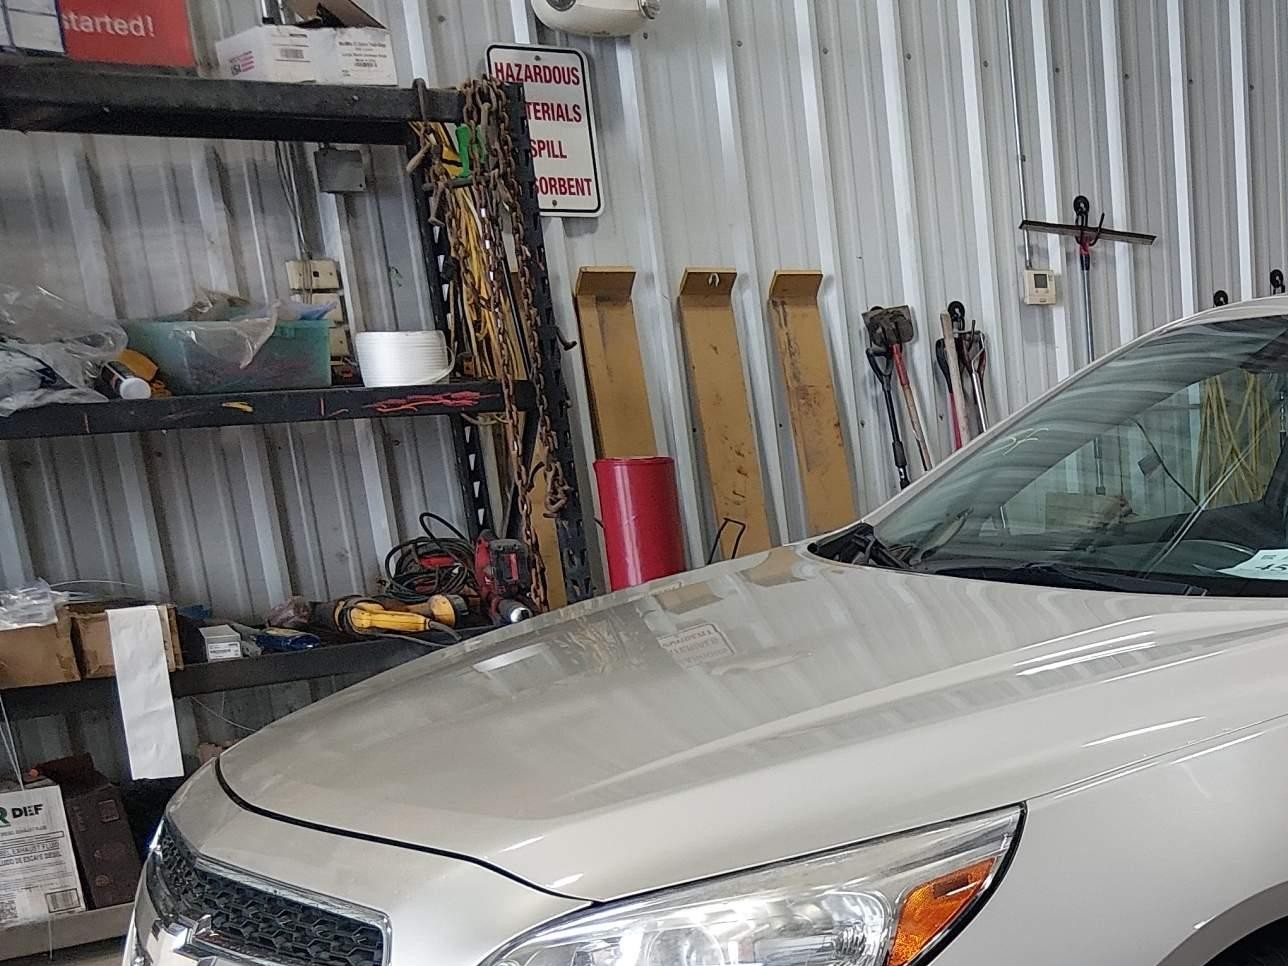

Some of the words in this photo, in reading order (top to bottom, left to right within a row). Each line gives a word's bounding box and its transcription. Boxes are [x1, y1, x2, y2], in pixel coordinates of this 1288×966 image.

[61, 11, 155, 38] started!
[494, 62, 580, 86] HAZARDOUS
[525, 101, 582, 123] TERIALS
[529, 139, 567, 159] SPILL
[533, 176, 593, 197] SORBENT
[11, 804, 43, 818] DEF
